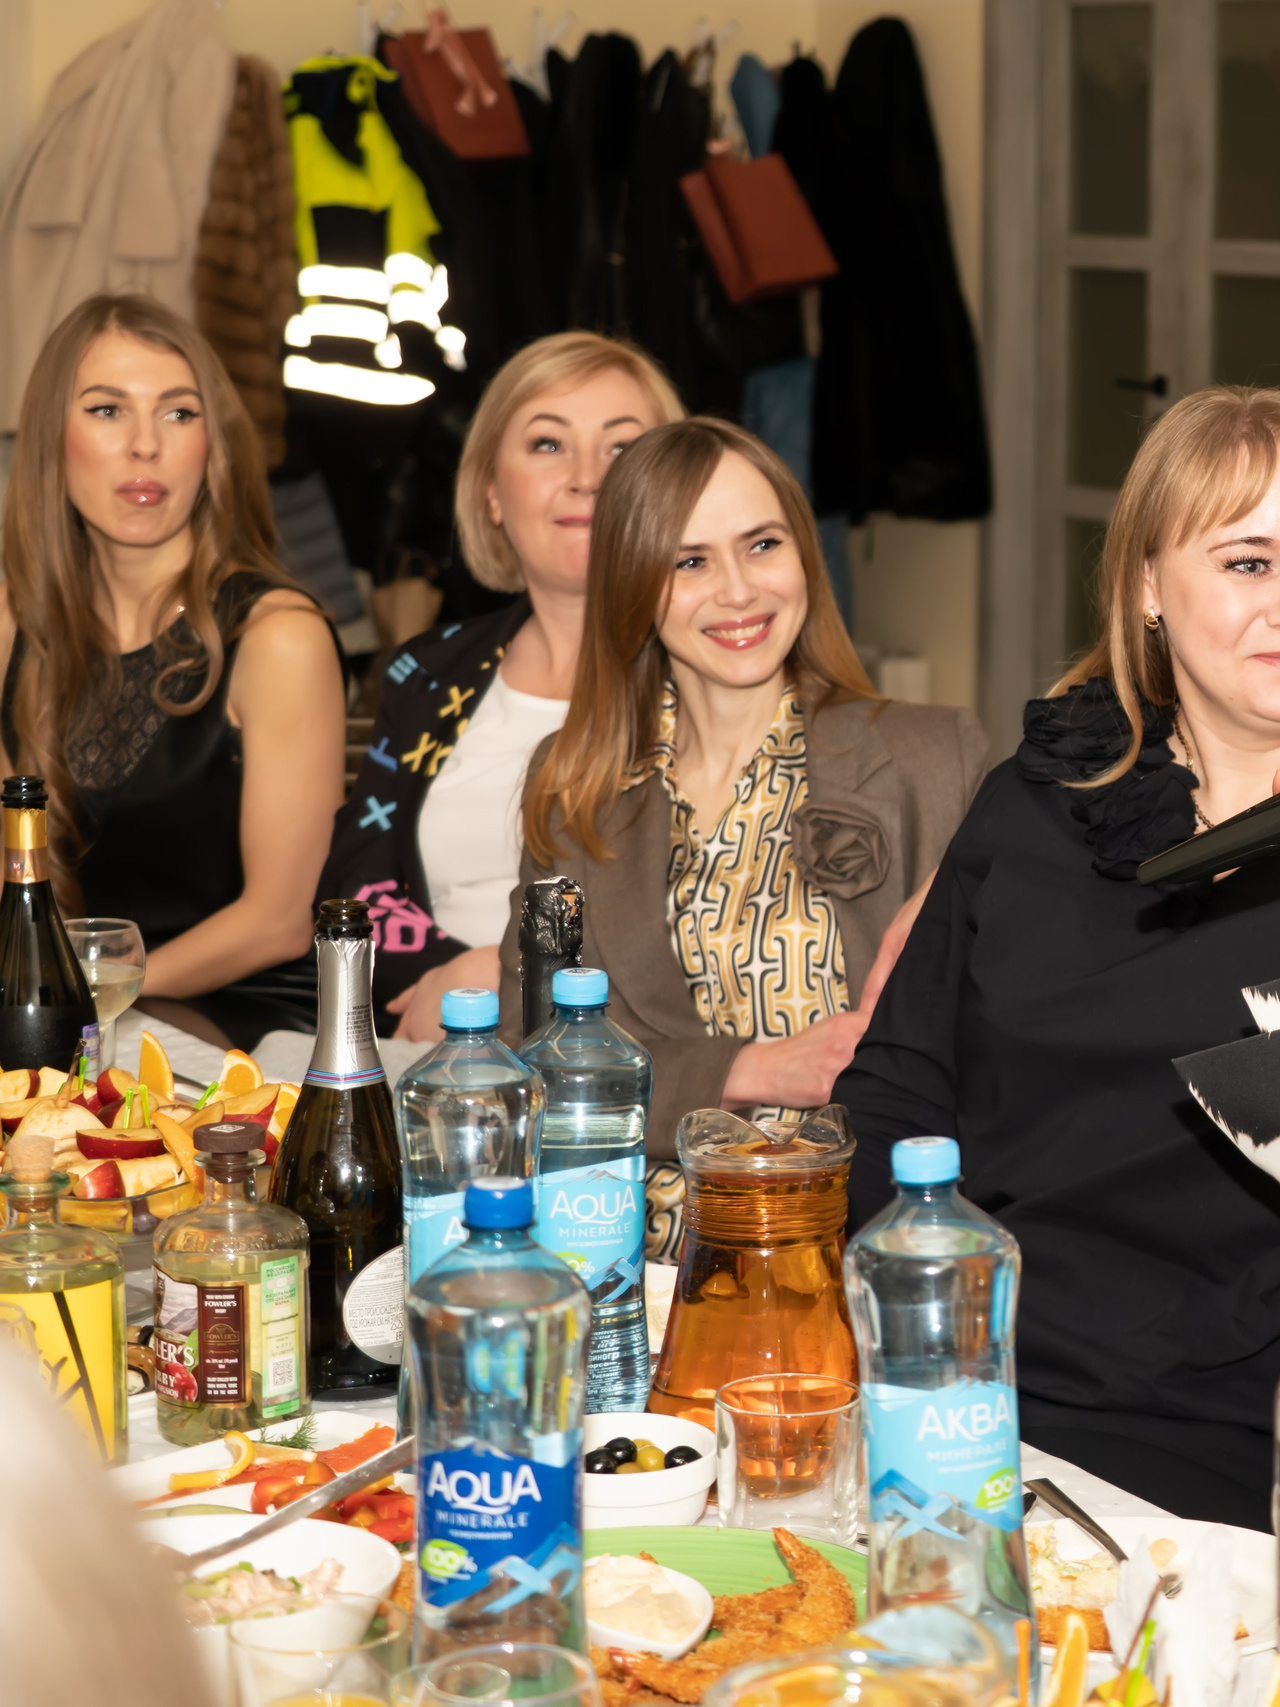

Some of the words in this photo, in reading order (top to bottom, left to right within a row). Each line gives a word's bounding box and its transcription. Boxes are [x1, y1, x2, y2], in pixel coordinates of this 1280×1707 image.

[549, 1185, 637, 1225] AQUA
[559, 1221, 631, 1238] MINERALE
[155, 1337, 194, 1367] LER'S
[916, 1393, 1012, 1442] АКВА
[426, 1460, 542, 1515] AQUA
[435, 1510, 530, 1529] MINERALE
[427, 1546, 478, 1573] 100%
